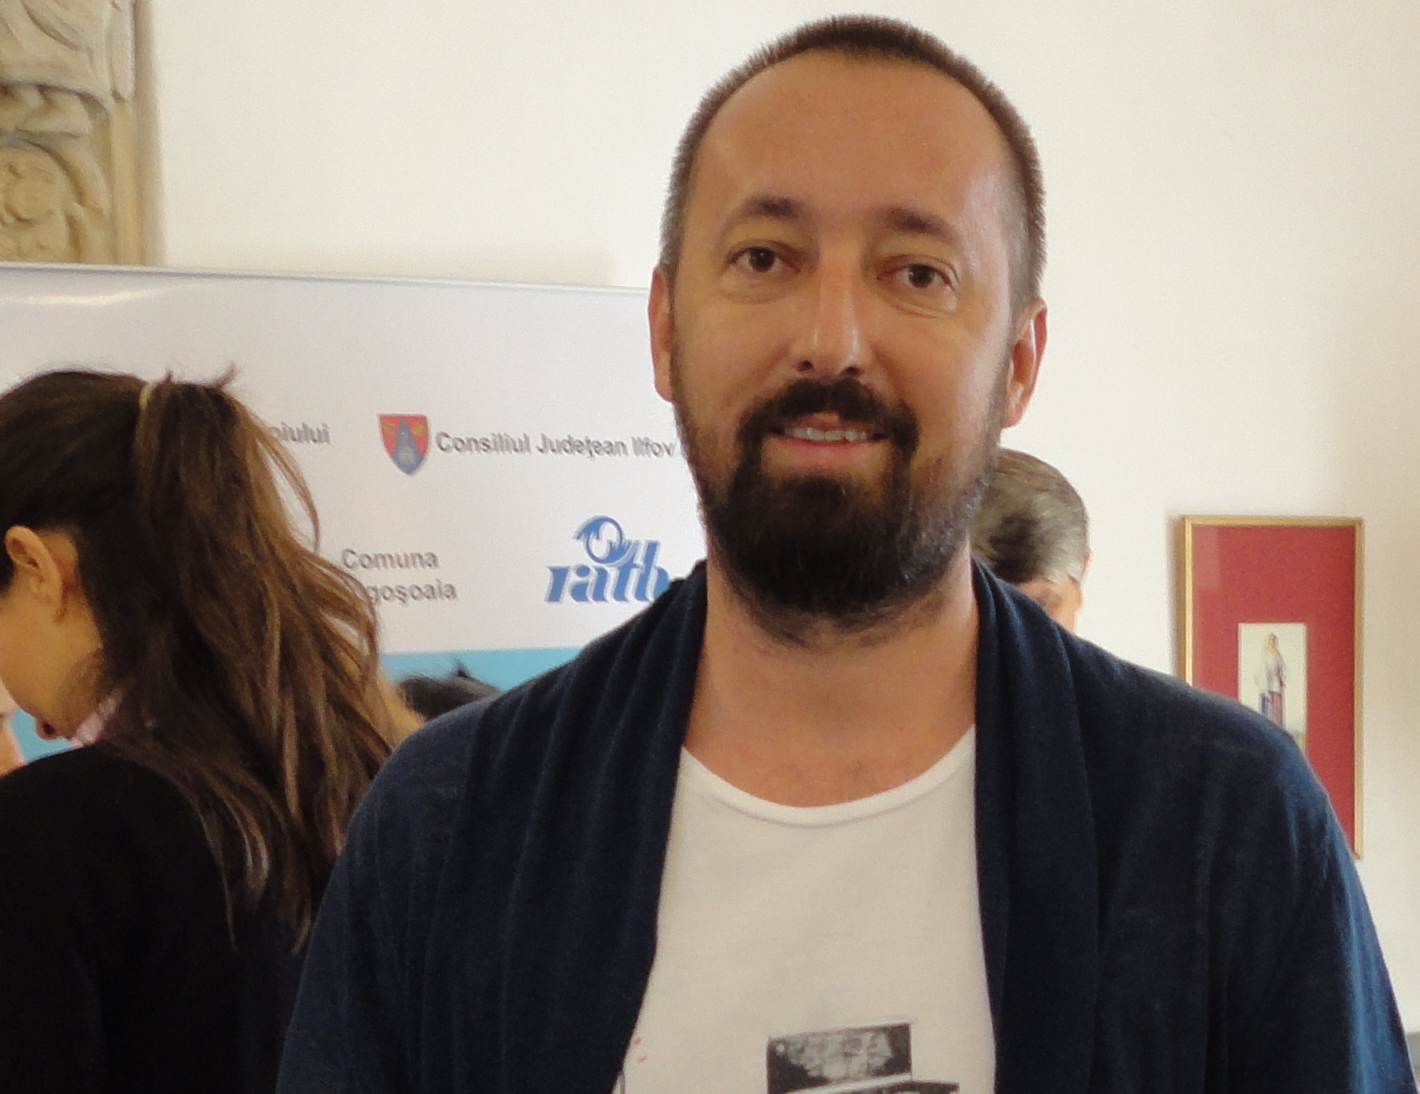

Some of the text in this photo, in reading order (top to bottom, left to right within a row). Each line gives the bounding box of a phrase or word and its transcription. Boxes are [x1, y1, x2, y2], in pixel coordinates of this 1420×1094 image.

[435, 431, 530, 456] Consiliul
[631, 436, 677, 458] Ilfov
[341, 548, 440, 571] Comuna
